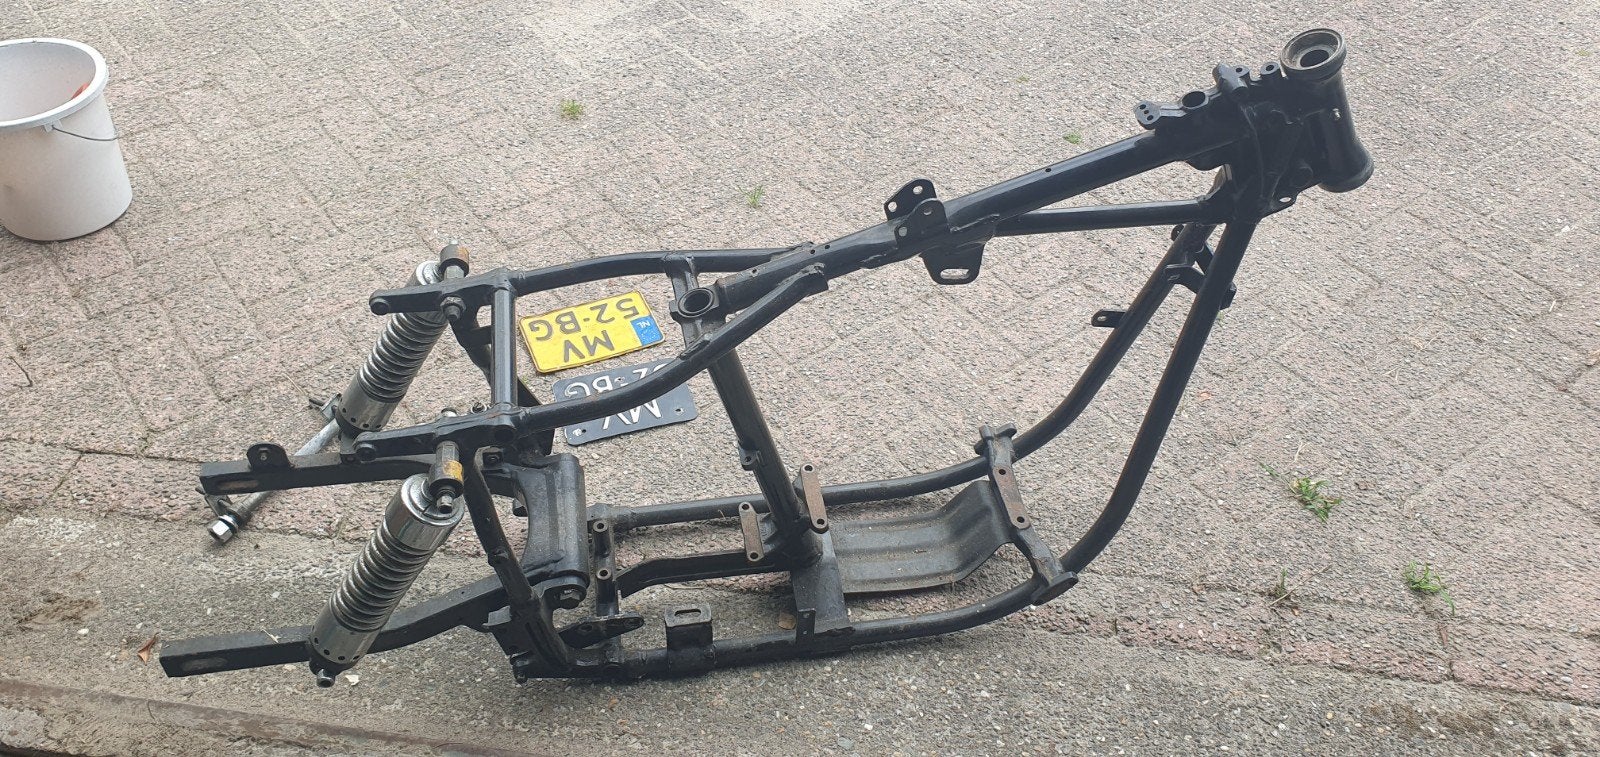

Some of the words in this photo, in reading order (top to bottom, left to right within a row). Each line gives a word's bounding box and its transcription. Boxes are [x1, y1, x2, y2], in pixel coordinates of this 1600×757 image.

[528, 298, 640, 341] 52-BG
[636, 321, 650, 329] NL
[563, 329, 615, 363] MV
[564, 363, 667, 398] 2-BG
